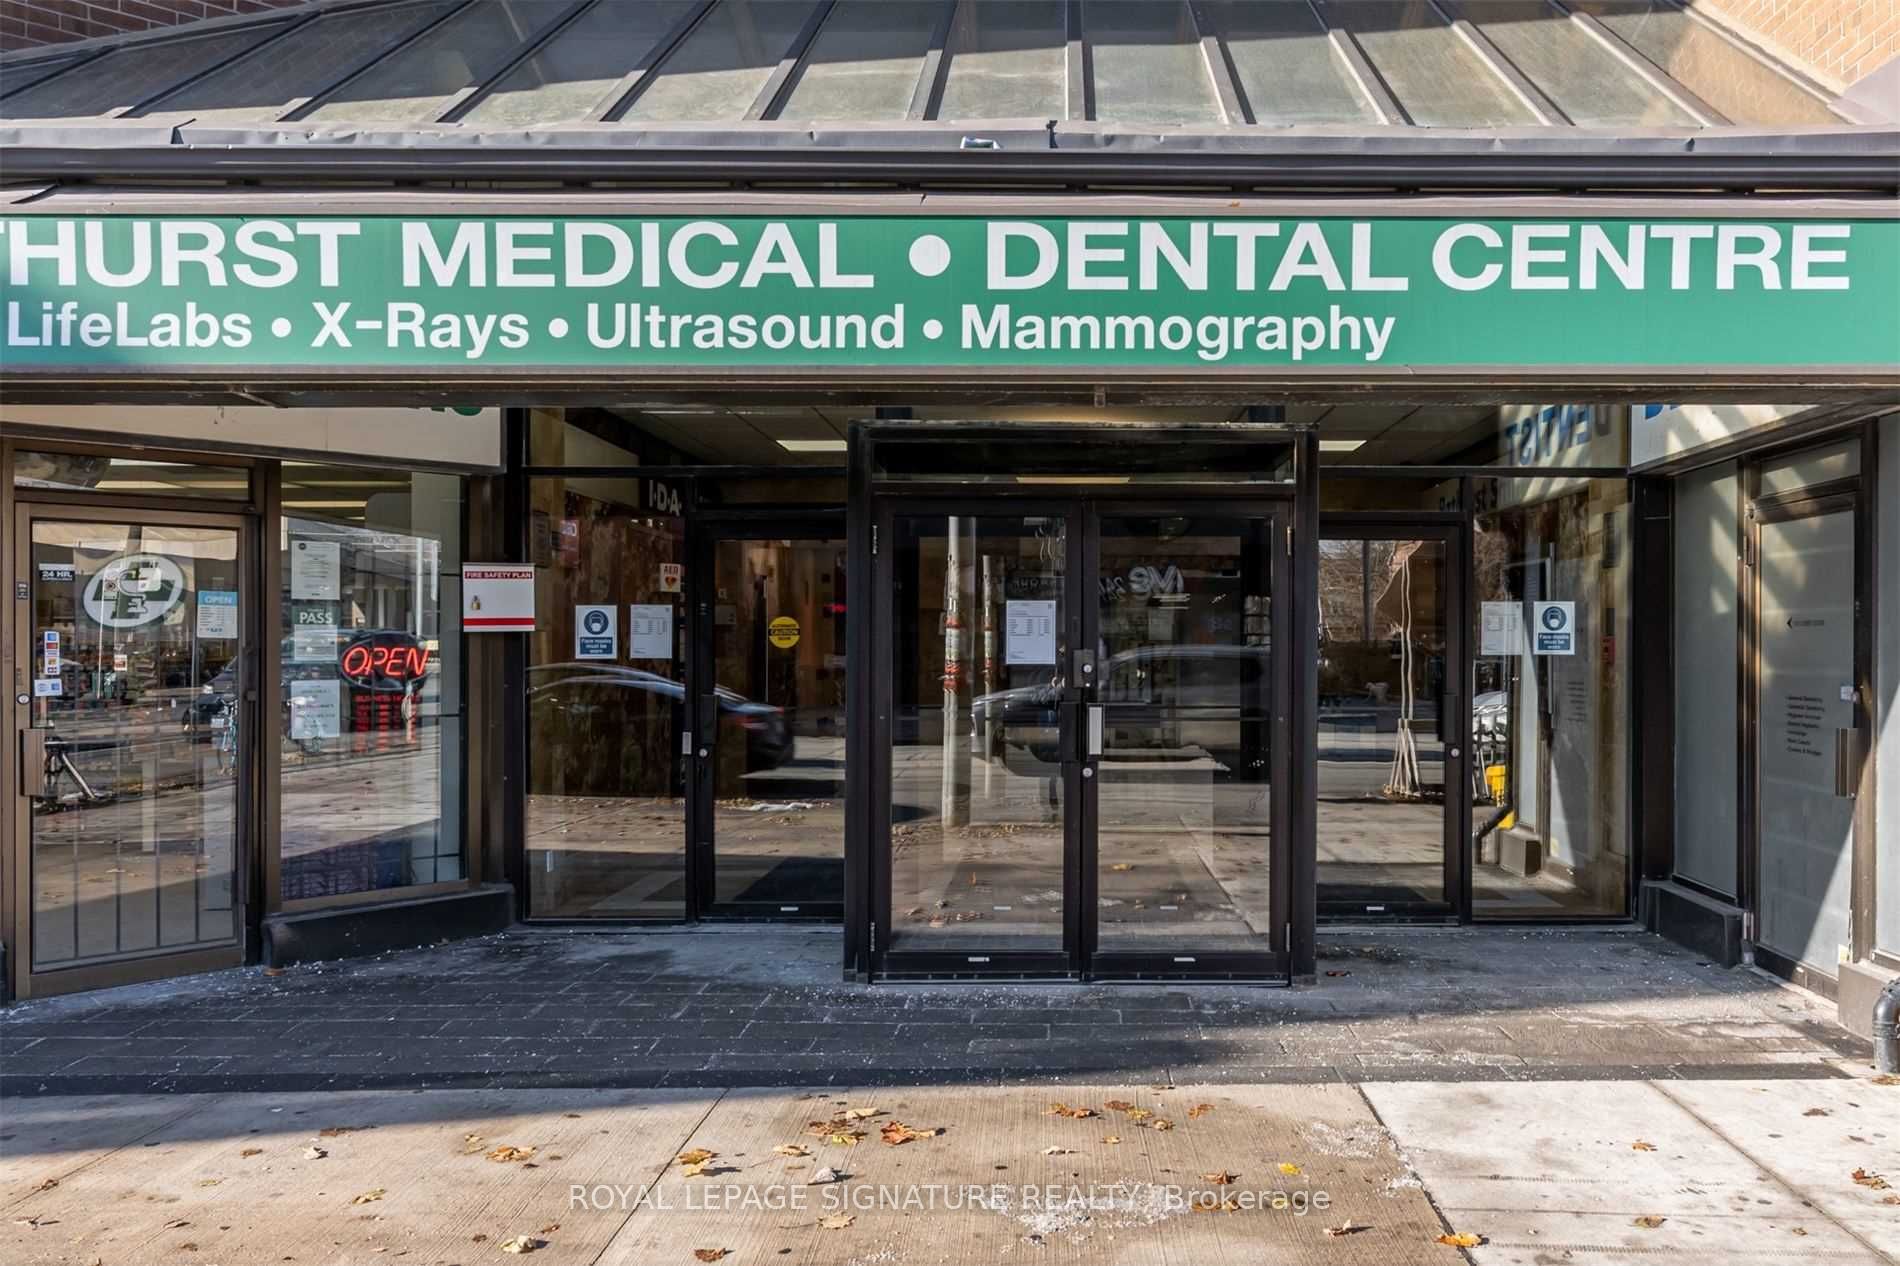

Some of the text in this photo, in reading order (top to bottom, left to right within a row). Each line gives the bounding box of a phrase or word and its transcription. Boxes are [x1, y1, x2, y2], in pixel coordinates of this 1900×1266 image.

[0, 220, 1851, 292] HURST MEDICAL DENTAL CENTRE
[8, 300, 1395, 361] LifeLabs X-Rays Ultrasound Mammography
[299, 611, 333, 624] PASS
[343, 646, 431, 677] OPEN
